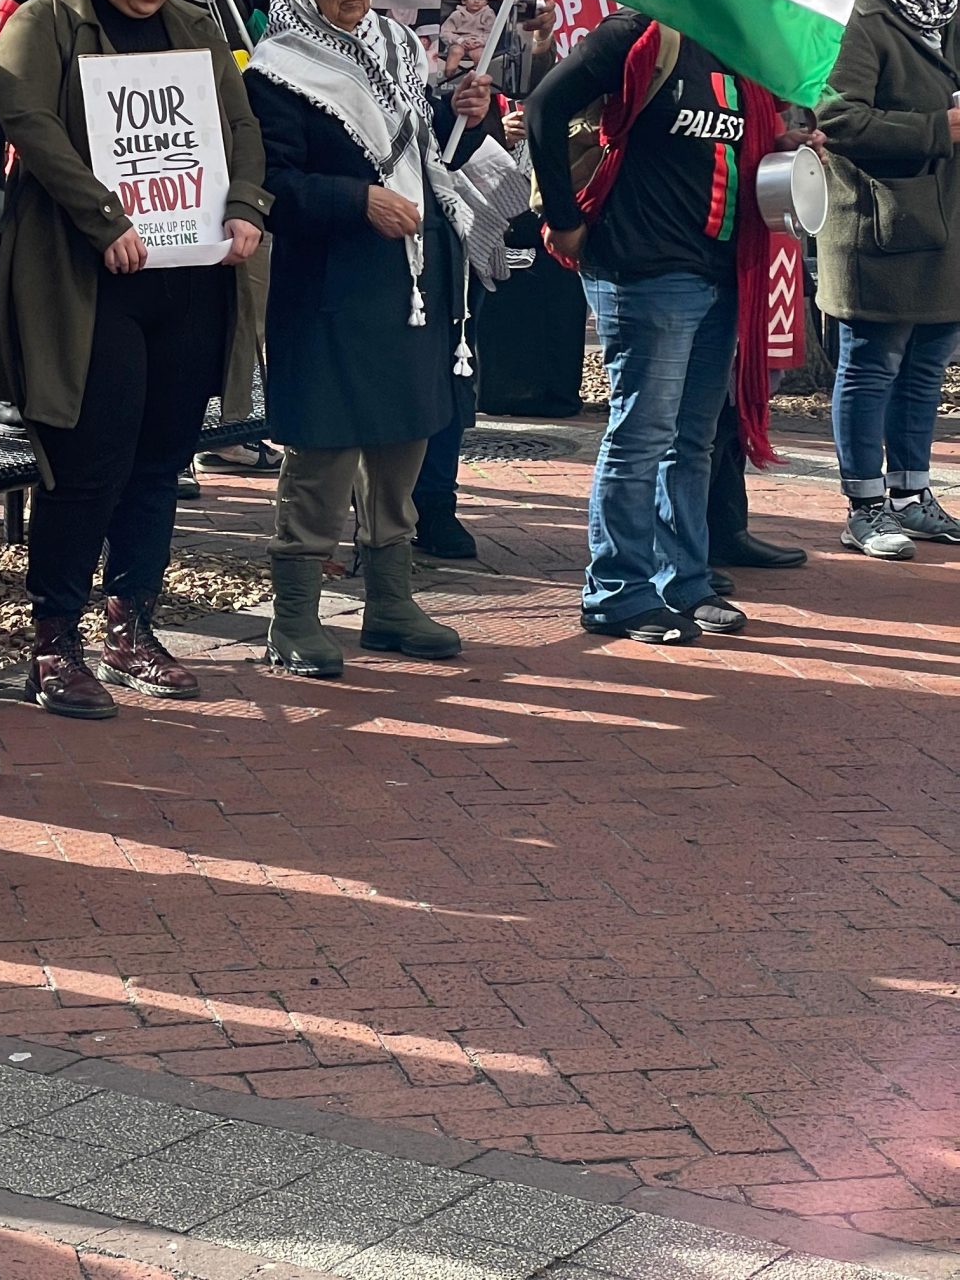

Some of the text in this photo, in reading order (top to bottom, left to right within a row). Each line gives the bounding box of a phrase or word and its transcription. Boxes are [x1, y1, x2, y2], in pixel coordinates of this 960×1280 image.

[107, 86, 194, 133] YOUR
[670, 109, 744, 141] PALEST
[113, 131, 199, 157] SILENCE
[116, 153, 200, 176] IS
[119, 167, 204, 216] DEADLY
[138, 220, 197, 235] SPEAK UP FOR
[140, 233, 198, 247] PALESTINE
